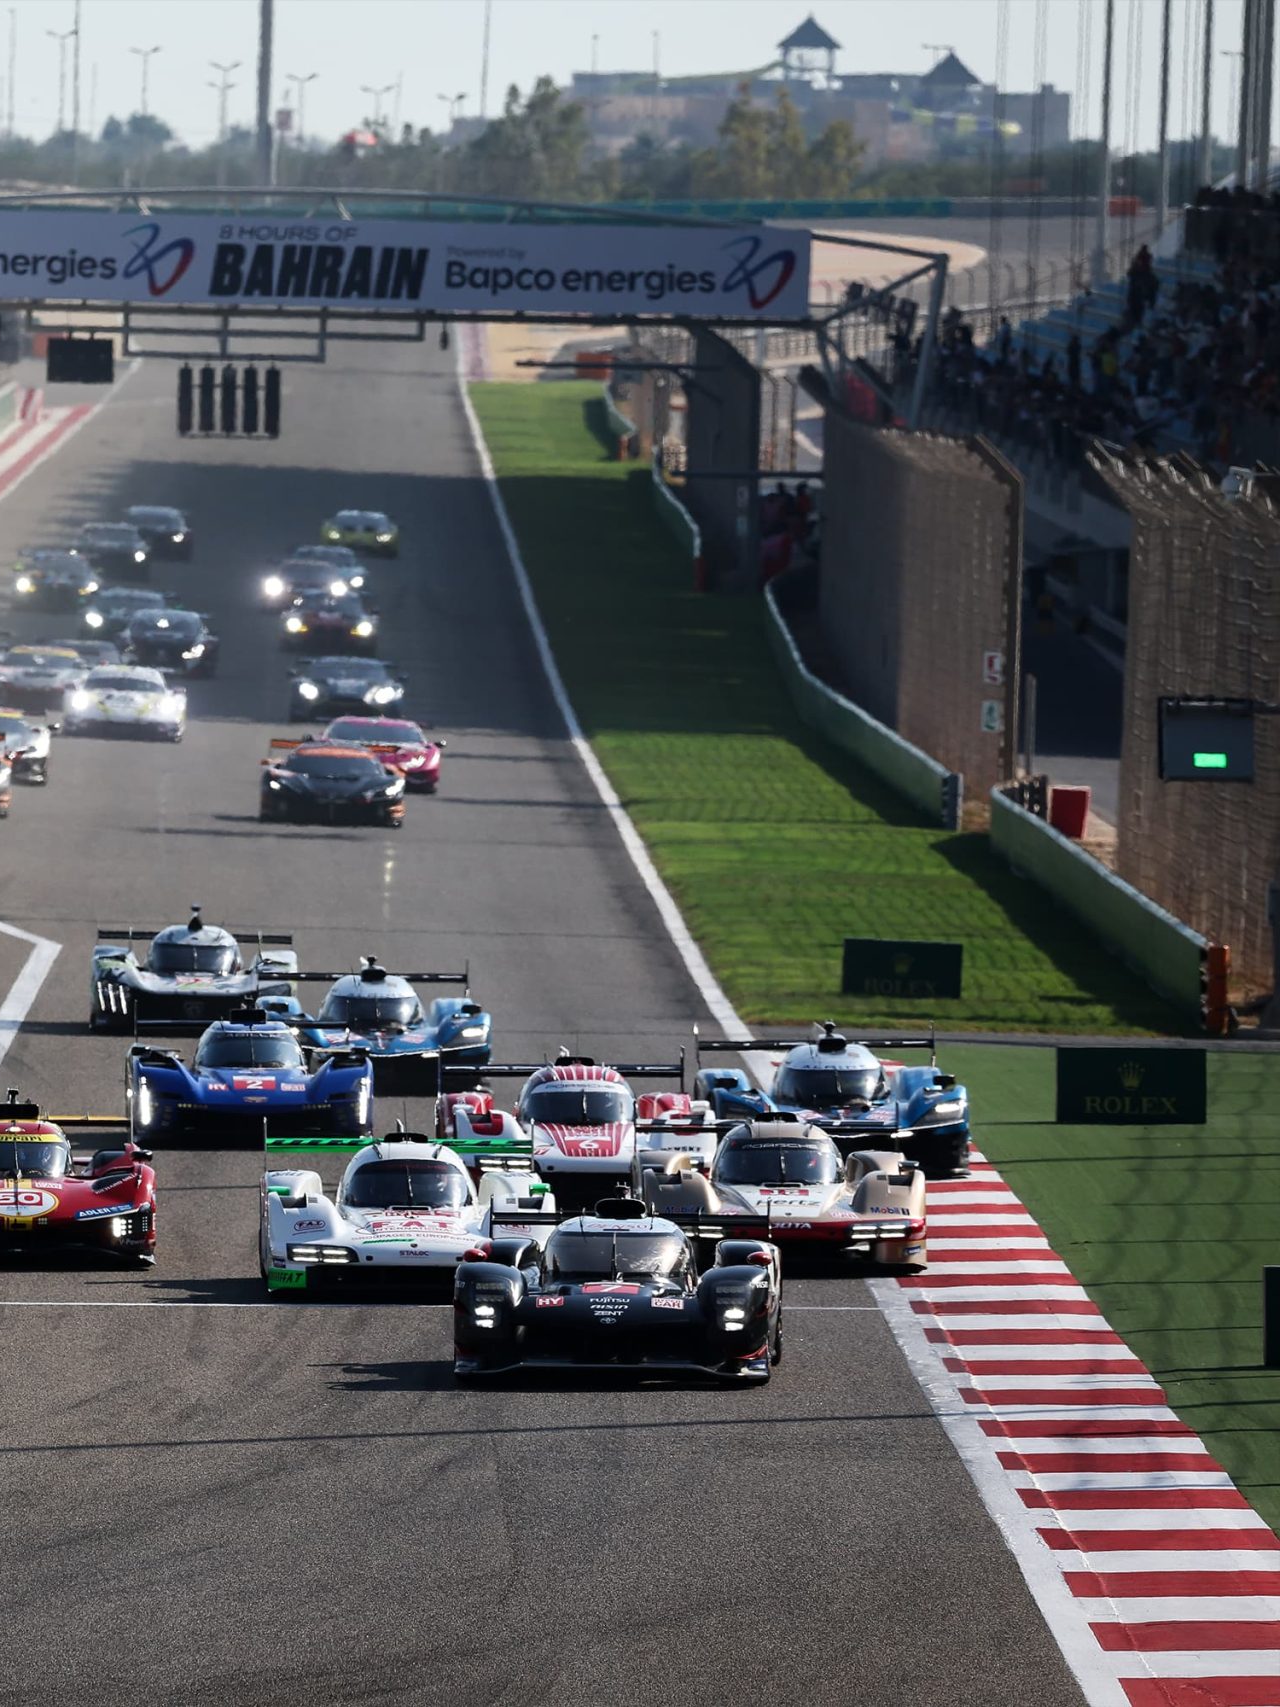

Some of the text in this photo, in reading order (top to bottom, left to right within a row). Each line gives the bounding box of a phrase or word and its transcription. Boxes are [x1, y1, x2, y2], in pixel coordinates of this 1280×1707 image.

[219, 225, 359, 242] 8 HOURS OF
[209, 243, 430, 299] BAHRAIN
[445, 260, 716, 300] Bapco energies
[863, 977, 937, 996] ROLEX
[246, 1079, 263, 1089] 2
[1084, 1096, 1177, 1115] ROLEX
[578, 1140, 599, 1149] 6
[756, 1198, 822, 1206] Hertz
[79, 1208, 111, 1218] ADLER
[870, 1206, 900, 1214] Mobil
[600, 1284, 623, 1293] 7
[538, 1296, 562, 1305] HY
[589, 1296, 631, 1304] FUJITSU
[654, 1301, 682, 1309] CAR
